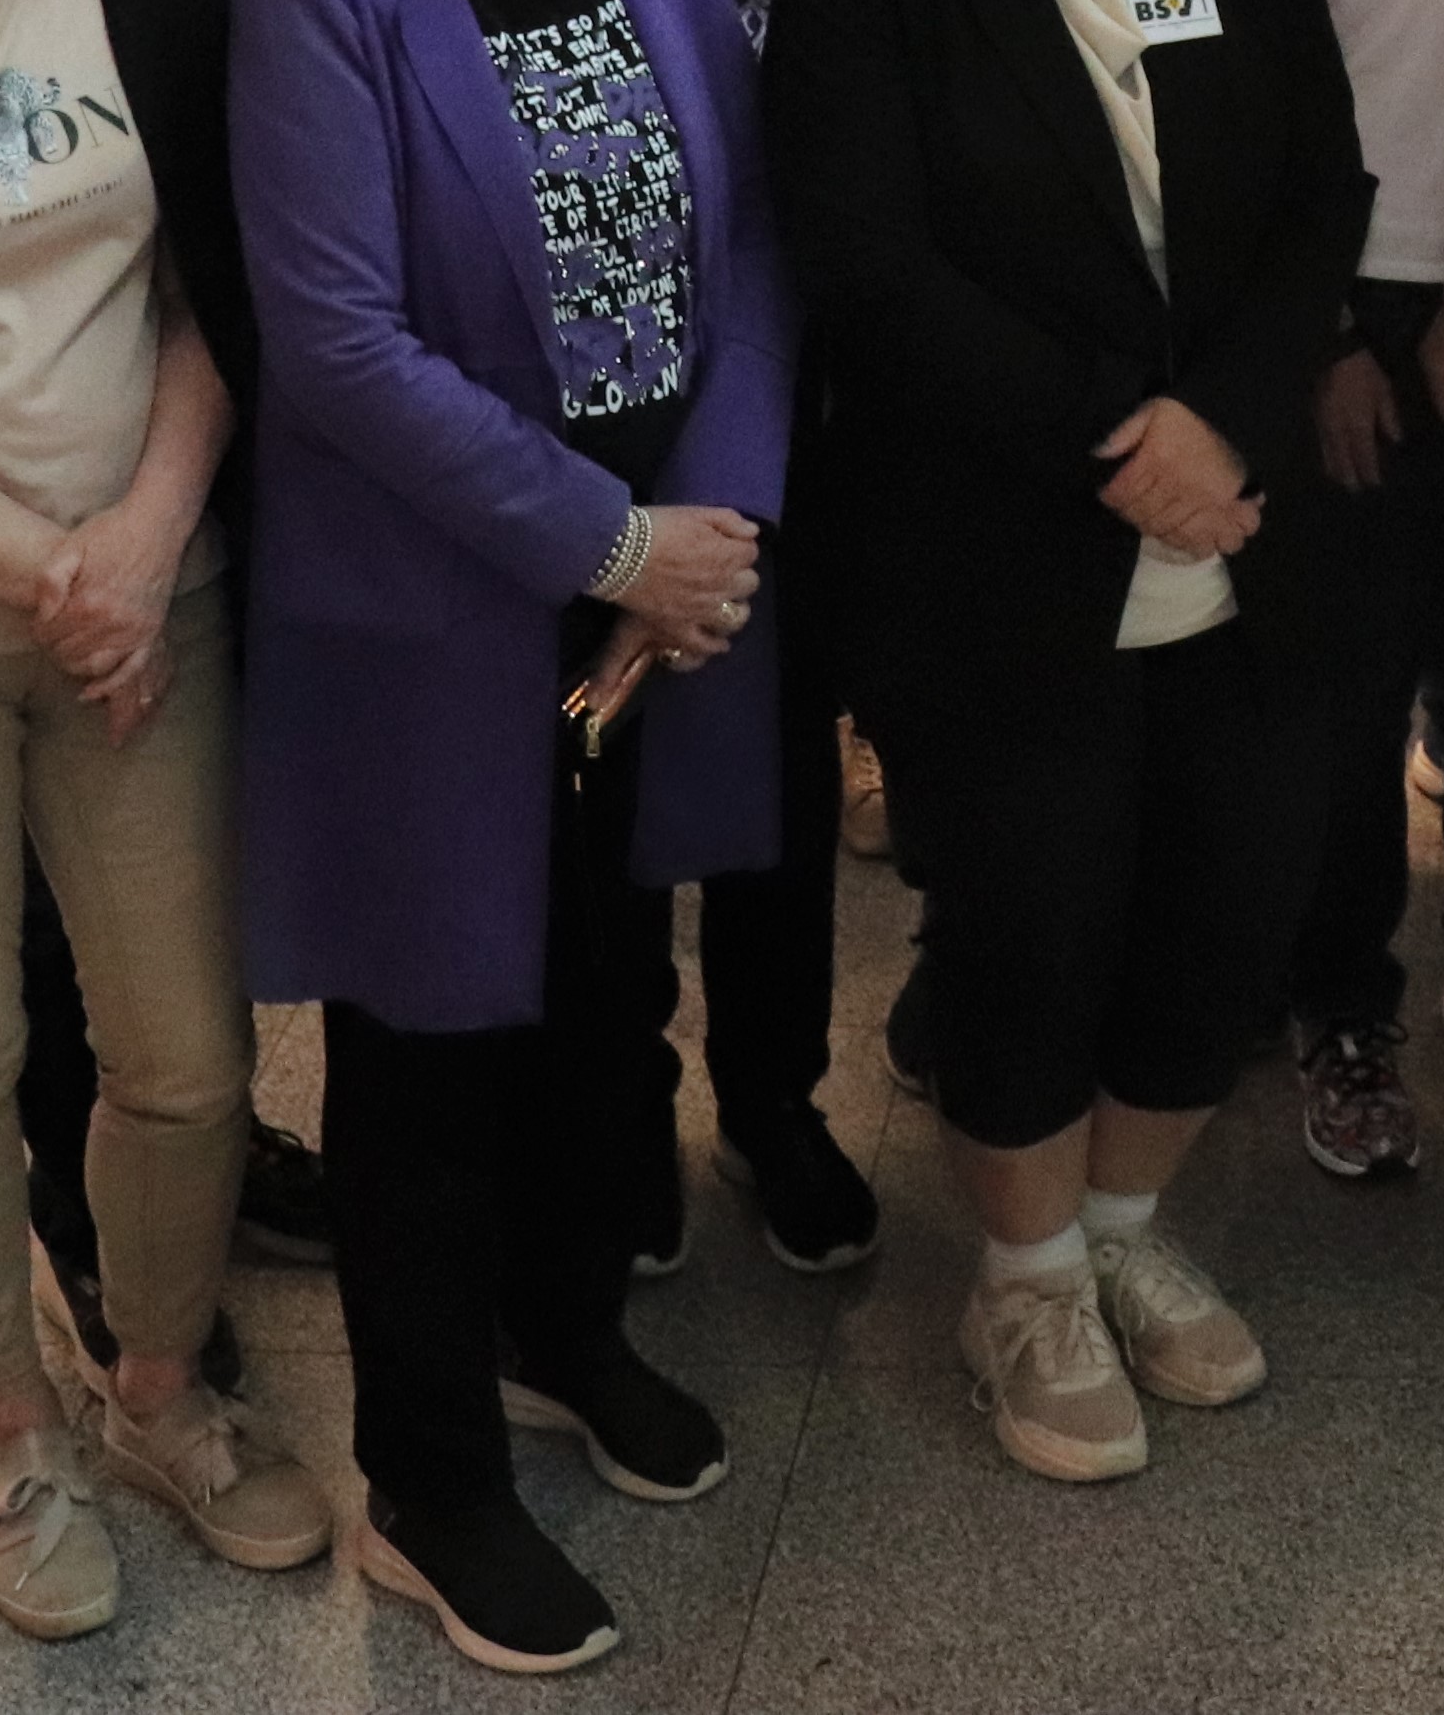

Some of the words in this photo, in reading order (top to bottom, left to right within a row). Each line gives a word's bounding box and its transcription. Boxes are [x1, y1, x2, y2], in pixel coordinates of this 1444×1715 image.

[534, 183, 587, 214] YOUR
[566, 205, 588, 231] OF
[632, 179, 672, 211] LIFE
[591, 294, 613, 318] OF
